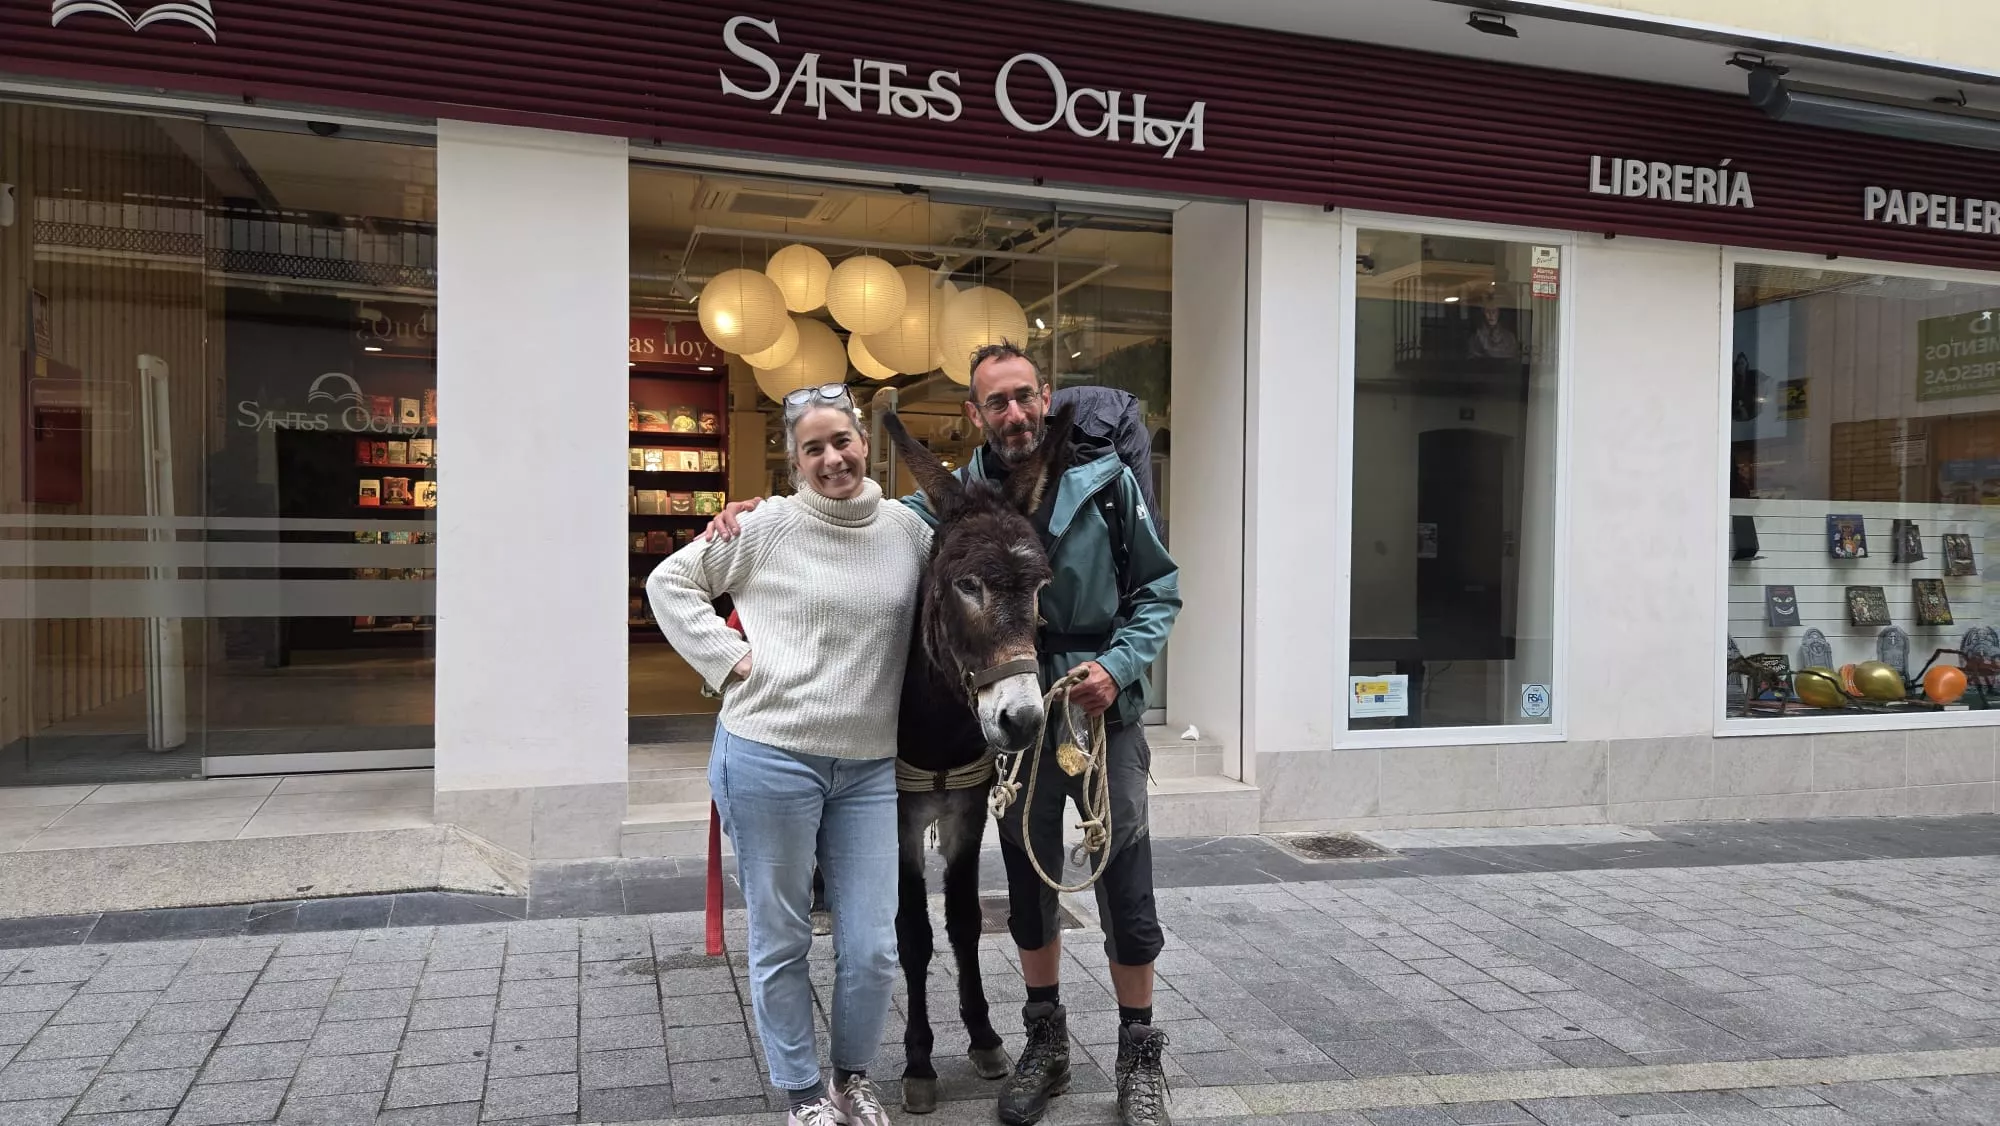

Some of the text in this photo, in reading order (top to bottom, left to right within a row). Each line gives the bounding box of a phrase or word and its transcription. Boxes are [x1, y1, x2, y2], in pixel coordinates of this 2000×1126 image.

[719, 15, 1207, 159] SANTOS OCHOA
[1589, 155, 1755, 209] LIBRERÍA
[1864, 185, 2000, 235] PAPELER
[237, 400, 429, 438] SANTOS OCHOA
